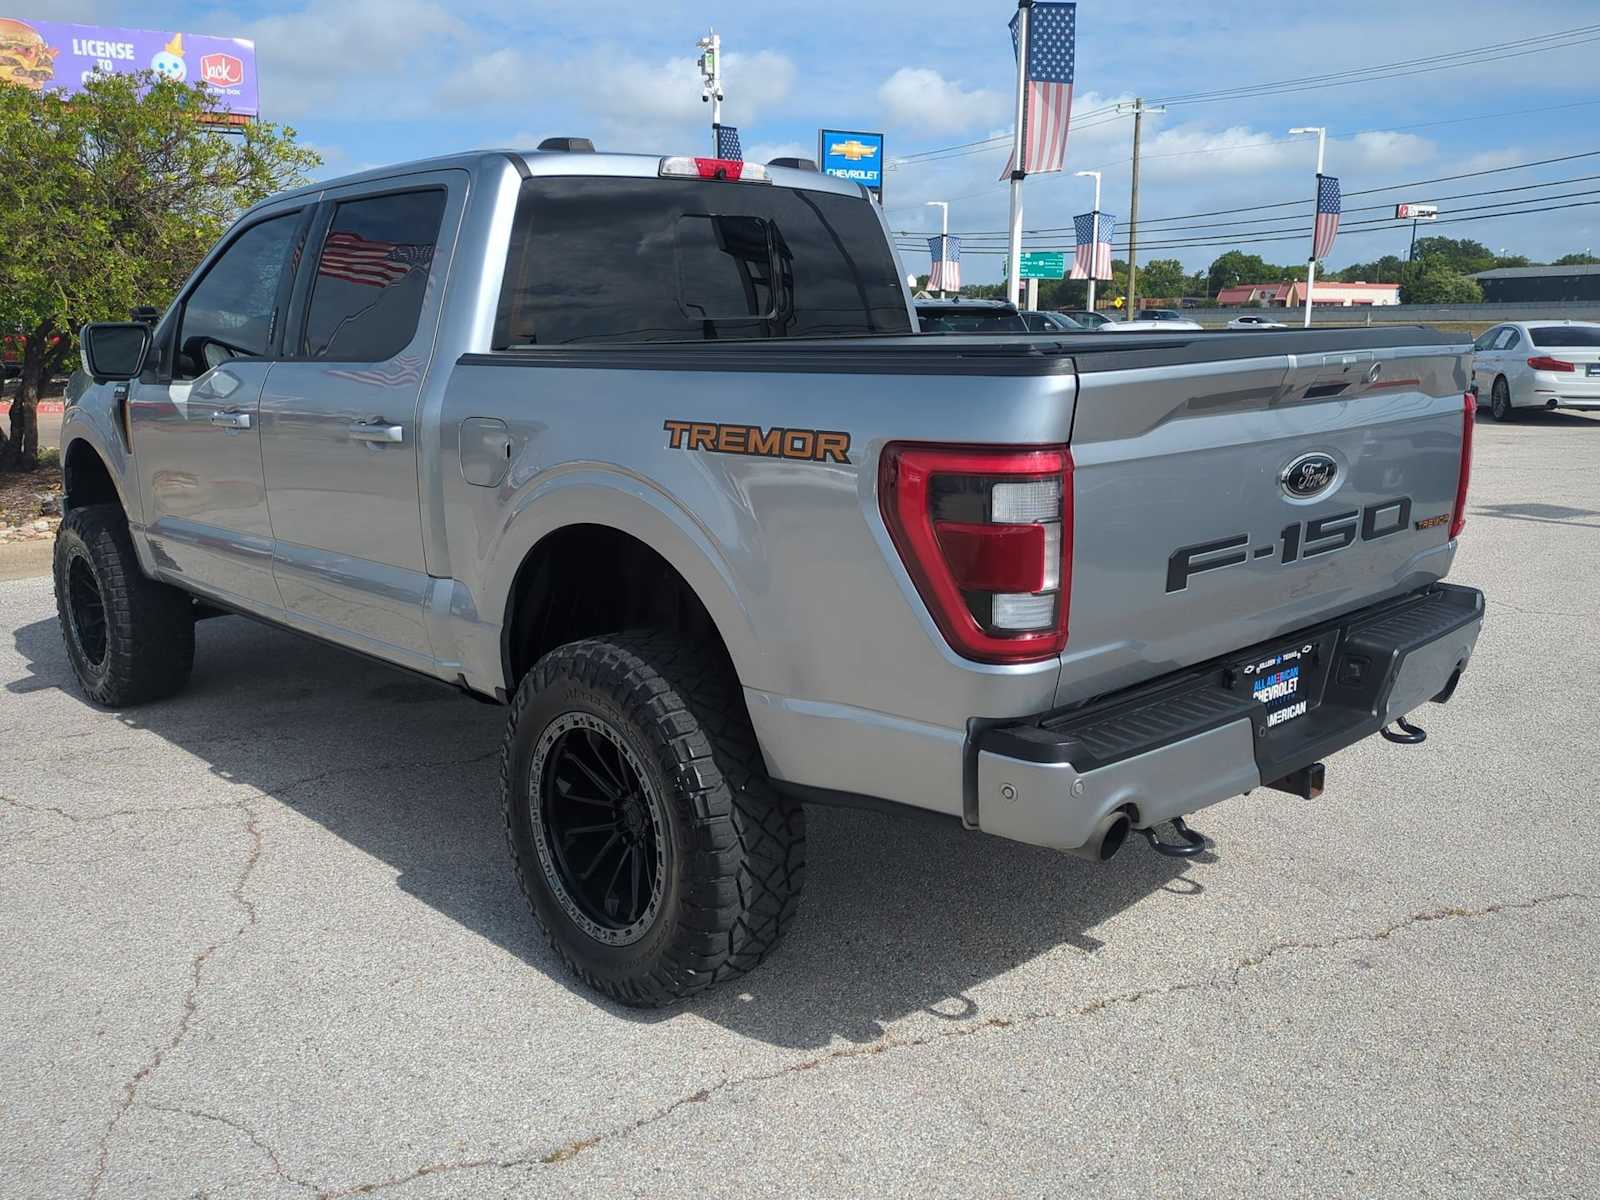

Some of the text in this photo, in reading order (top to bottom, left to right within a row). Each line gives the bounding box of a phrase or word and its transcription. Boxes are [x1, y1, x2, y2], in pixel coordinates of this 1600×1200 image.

[73, 39, 134, 60] LICENSE
[96, 59, 112, 72] TO
[204, 57, 241, 82] Jack
[826, 168, 880, 180] CHEVROLET
[664, 420, 852, 464] TREMOR
[1298, 463, 1329, 489] Ford
[1165, 496, 1412, 595] F-150
[1253, 677, 1299, 703] CHEVROLET
[1254, 667, 1299, 691] ALL AMERICAN
